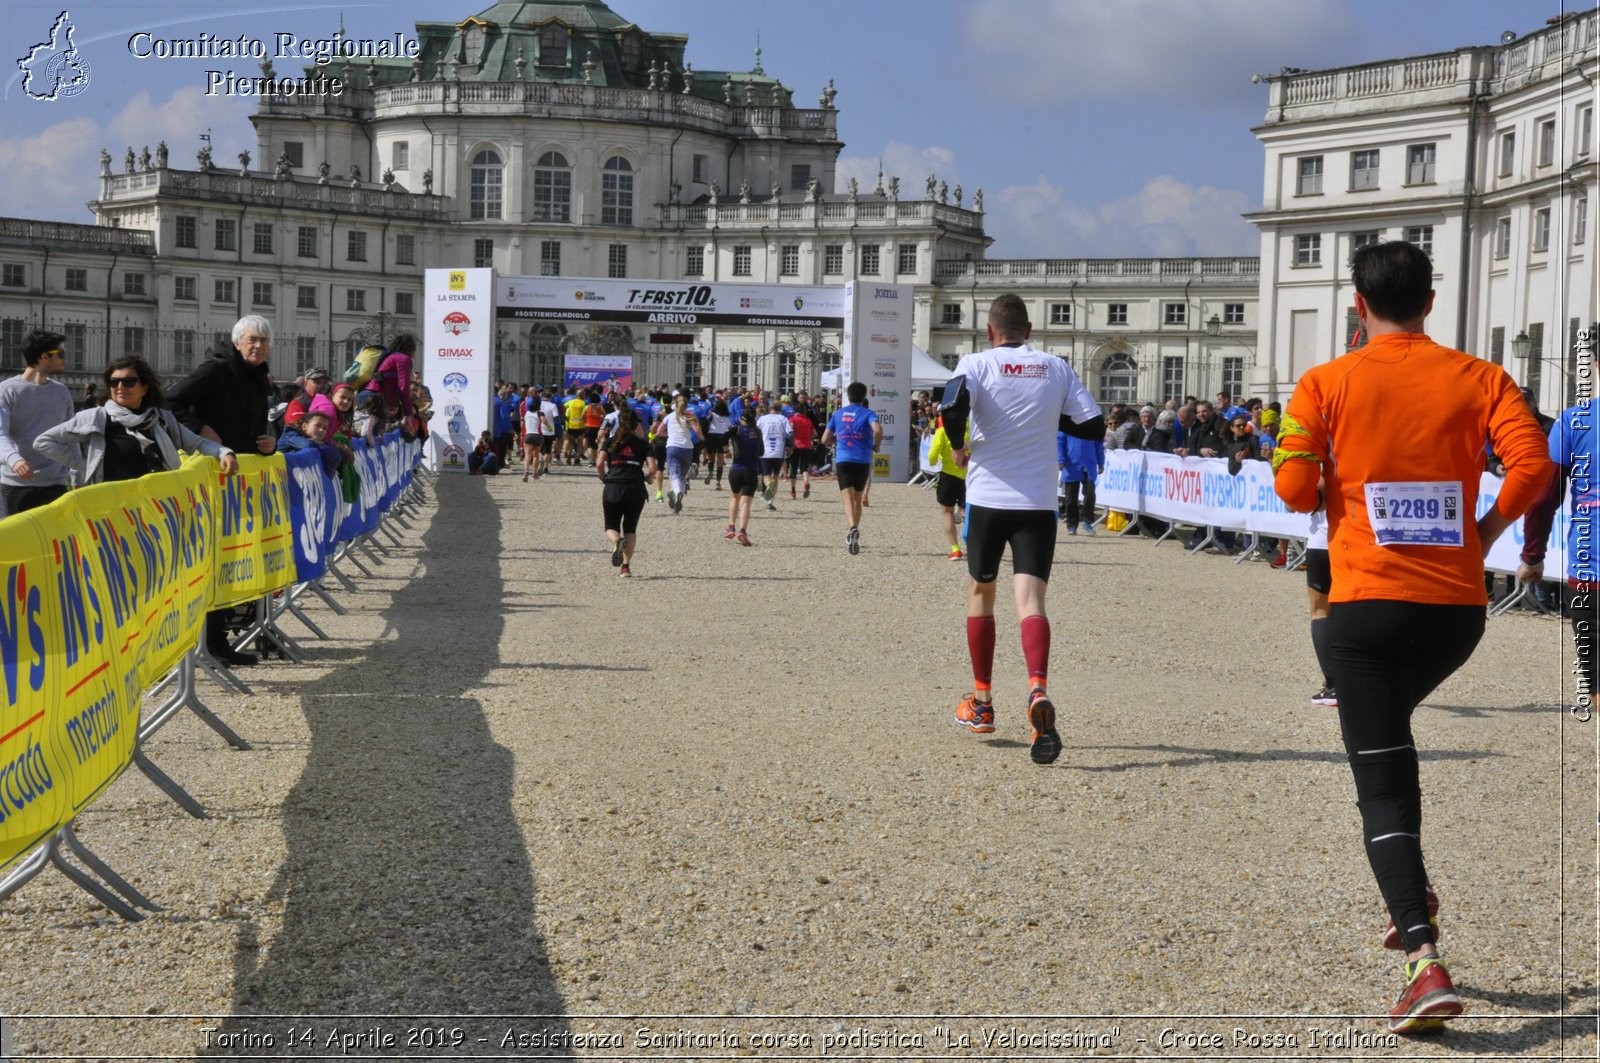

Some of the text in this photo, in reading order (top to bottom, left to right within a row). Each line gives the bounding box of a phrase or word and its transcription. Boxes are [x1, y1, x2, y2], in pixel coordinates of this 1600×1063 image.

[515, 311, 590, 319] #SOSTIENICANDIOLO
[648, 313, 697, 324] ARRIVO
[748, 318, 821, 326] #SOSTIENICANDIOLO
[438, 348, 473, 357] GIMAX
[568, 372, 599, 380] T-FAST
[1164, 467, 1202, 504] TOYOTA
[1204, 472, 1247, 510] HYBRID
[218, 471, 254, 537] iN's
[1389, 498, 1439, 519] 2289
[218, 550, 253, 585] mercato
[53, 534, 104, 669] iN's
[66, 679, 119, 766] mercato
[0, 732, 54, 824] rcato
